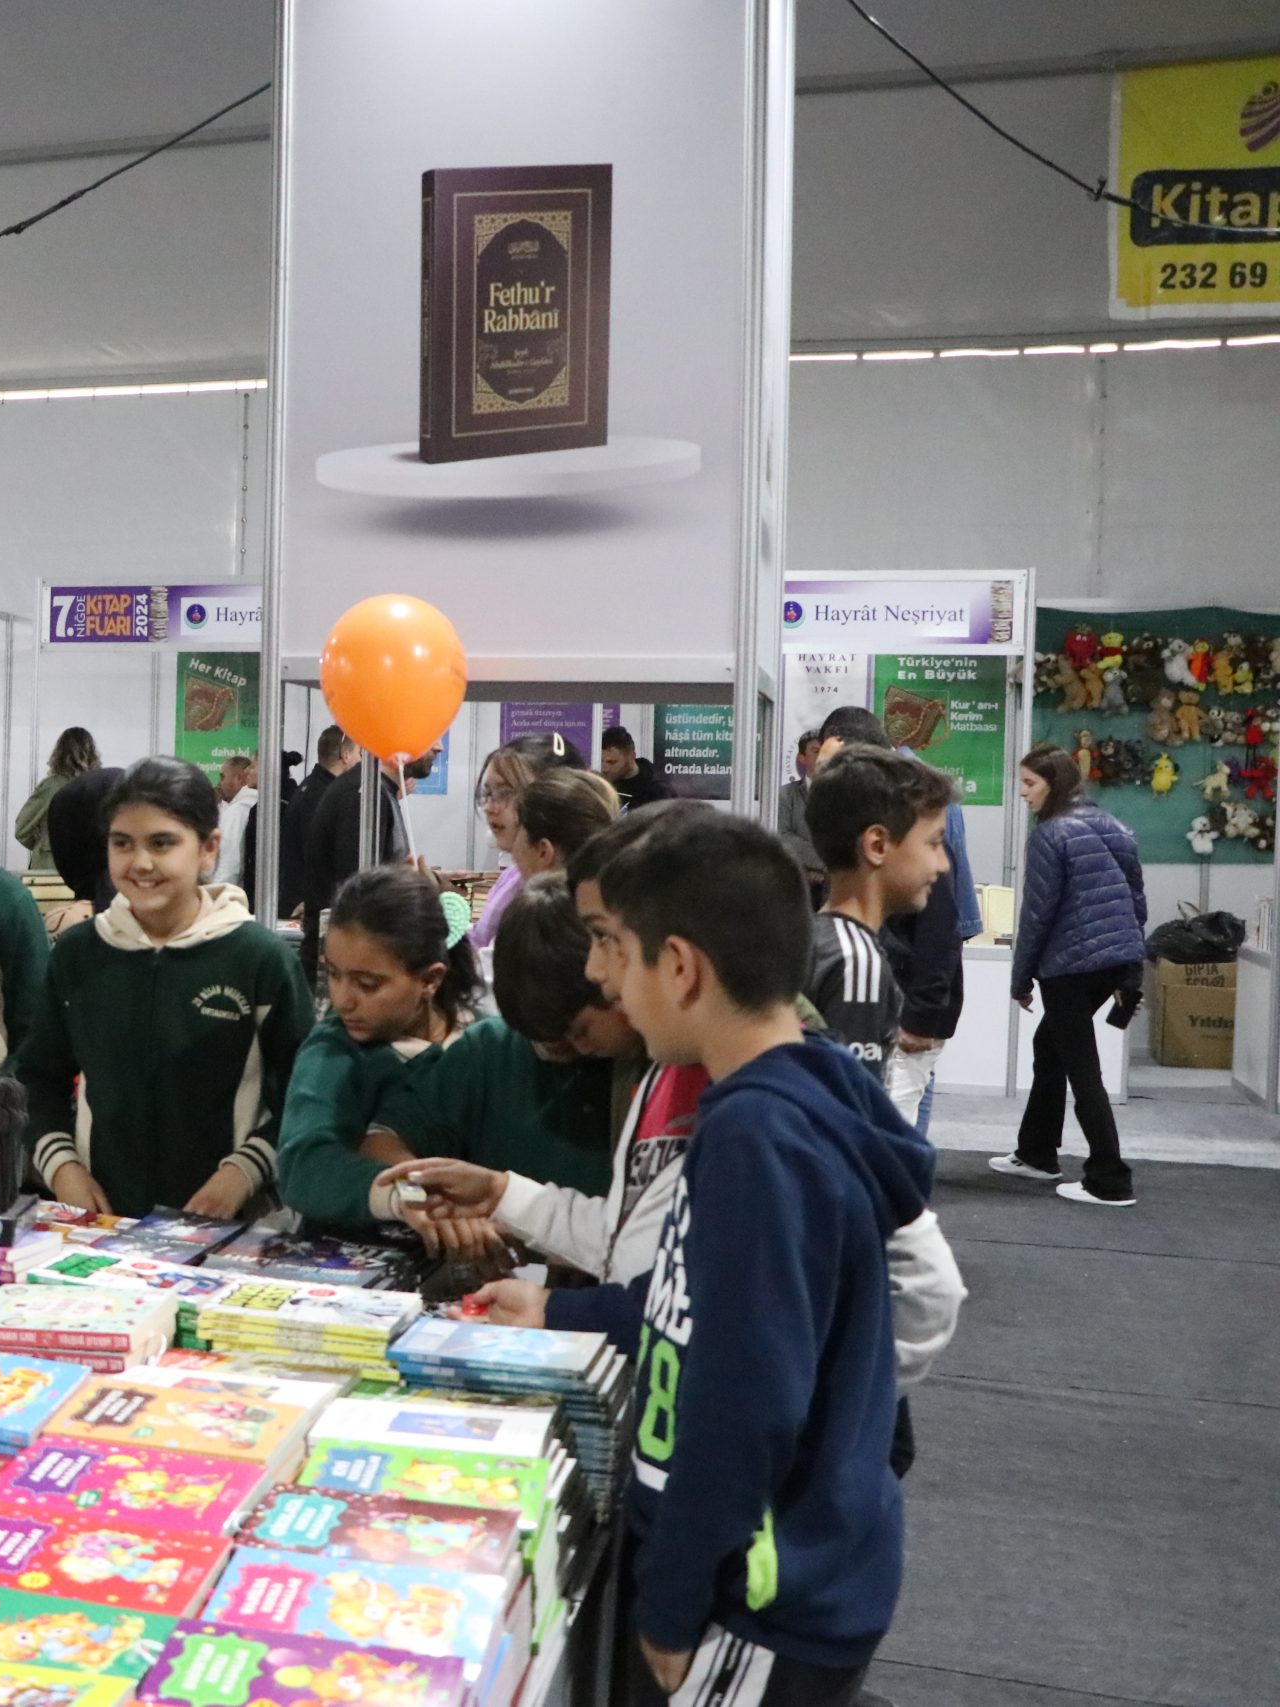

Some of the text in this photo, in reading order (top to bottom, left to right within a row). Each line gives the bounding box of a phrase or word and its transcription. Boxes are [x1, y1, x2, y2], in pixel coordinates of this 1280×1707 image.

[1160, 261, 1267, 289] 232 69
[489, 280, 556, 307] Fethu'r
[86, 594, 131, 614] KİTAP
[135, 593, 149, 636] 2024
[215, 606, 262, 627] Hayrâ
[815, 604, 965, 626] Hayrât Neşriyat
[86, 616, 131, 636] FUARI
[898, 656, 977, 668] Türkiye'nin
[189, 658, 247, 688] Her Kitap
[898, 669, 977, 681] En Büyük
[814, 686, 838, 694] 1974
[665, 713, 726, 726] üstündedir,
[951, 721, 997, 732] Matbaası
[692, 730, 713, 741] tüm
[665, 746, 719, 758] altındadır.
[665, 763, 733, 775] Ortada kalan
